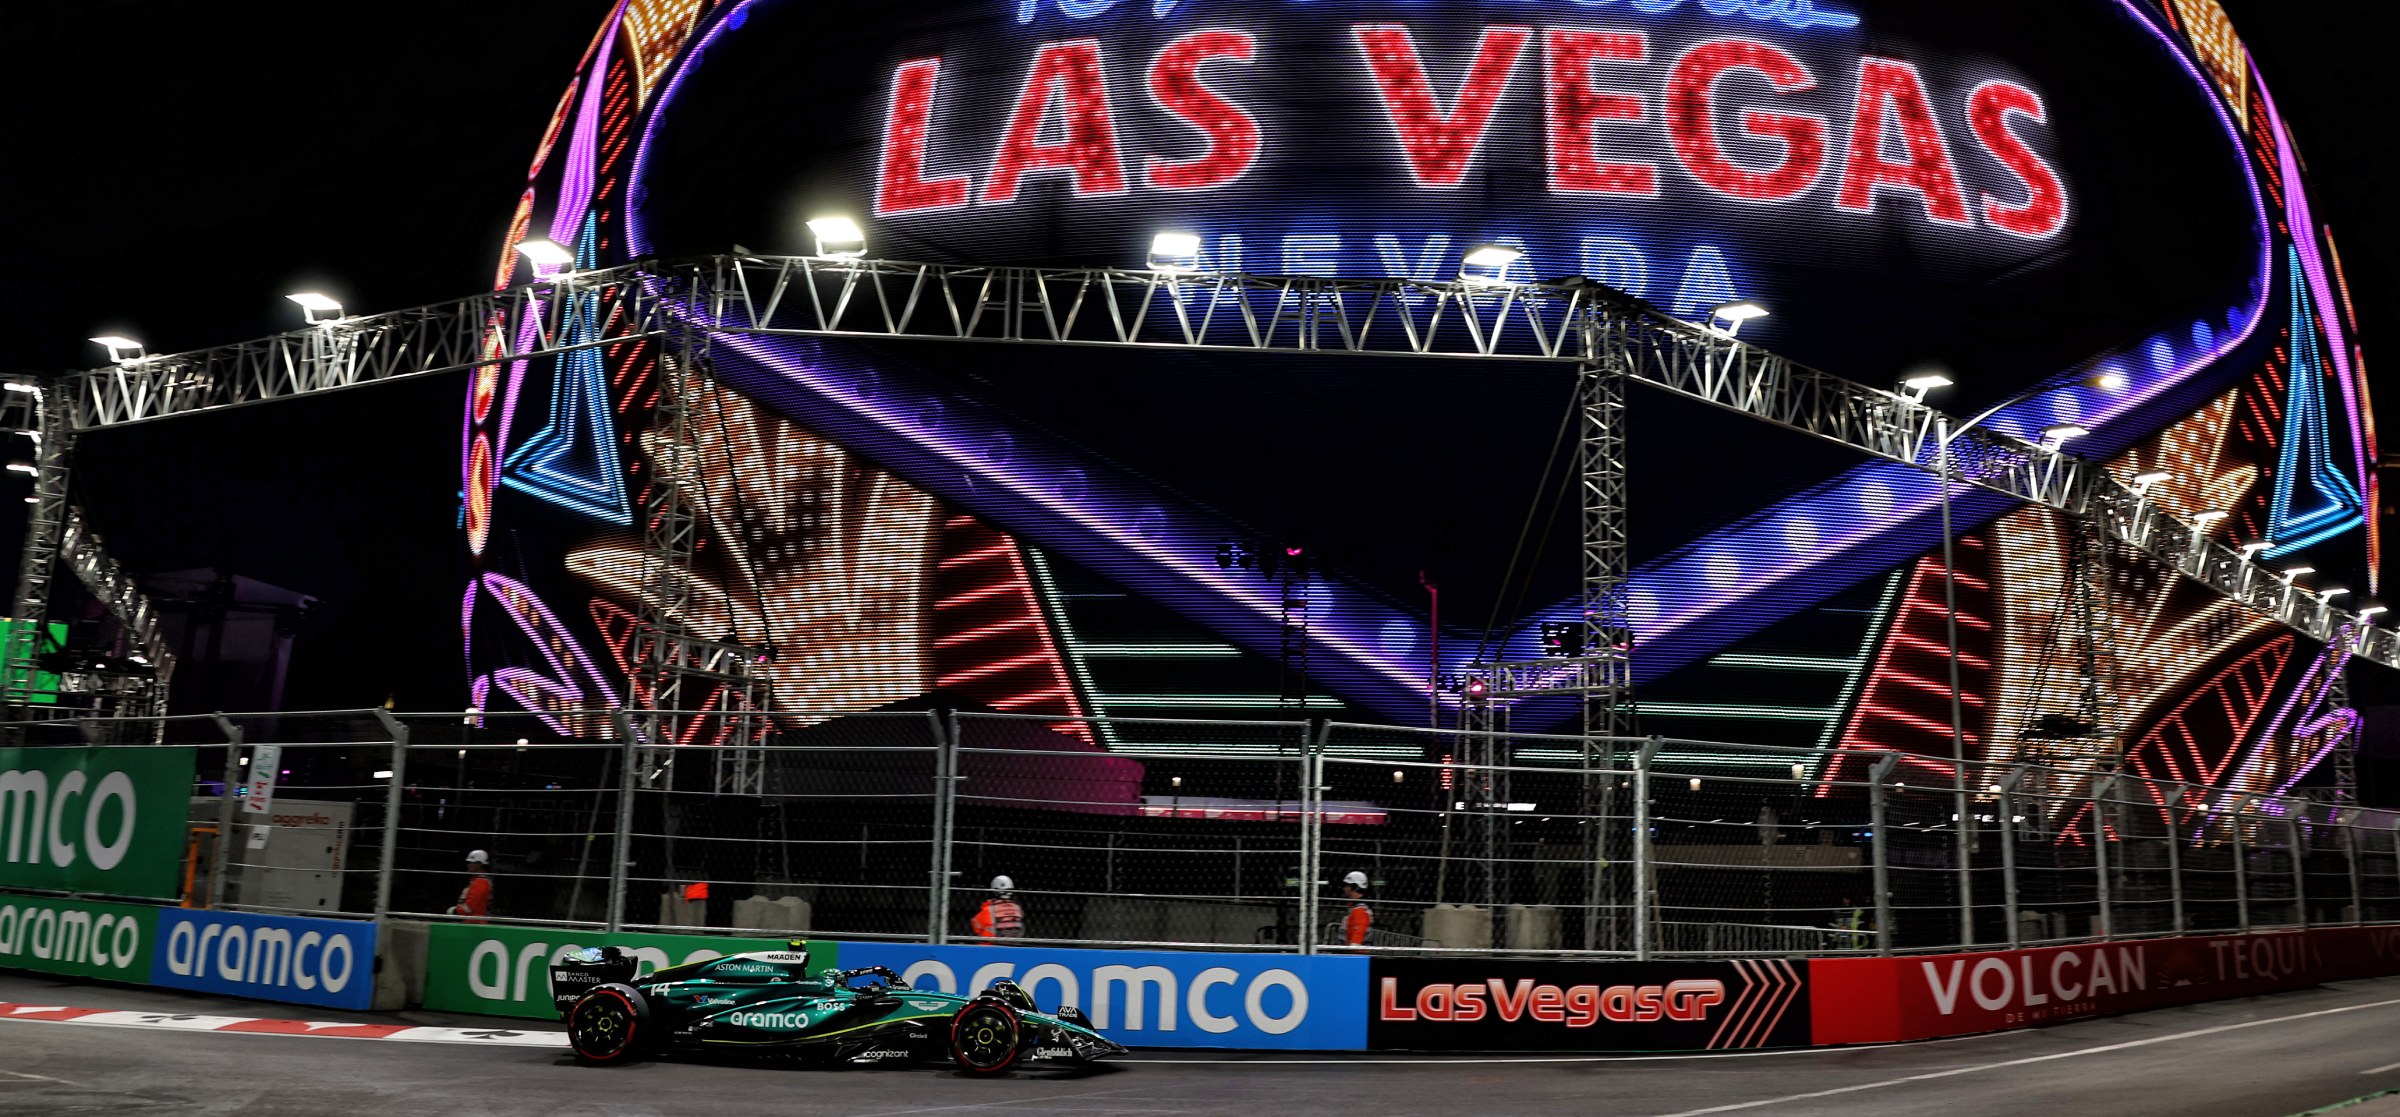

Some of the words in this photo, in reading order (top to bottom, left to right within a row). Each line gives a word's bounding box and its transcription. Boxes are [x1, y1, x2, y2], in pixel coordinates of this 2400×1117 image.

[873, 29, 1262, 217] LAS
[1350, 22, 2069, 240] VEGAS
[1176, 233, 1743, 317] NEVADA
[272, 812, 331, 828] aggreko
[0, 904, 139, 968] aramco
[167, 920, 353, 993] aramco
[767, 953, 801, 961] MAADEN
[715, 963, 741, 972] ASTON
[742, 964, 774, 973] MARTIN
[568, 976, 601, 984] MASTER
[1921, 944, 2147, 1016] VOLCAN
[650, 983, 670, 997] 14
[817, 1002, 846, 1011] BOSS
[730, 1011, 809, 1028] aramco
[865, 1049, 909, 1060] cognizant
